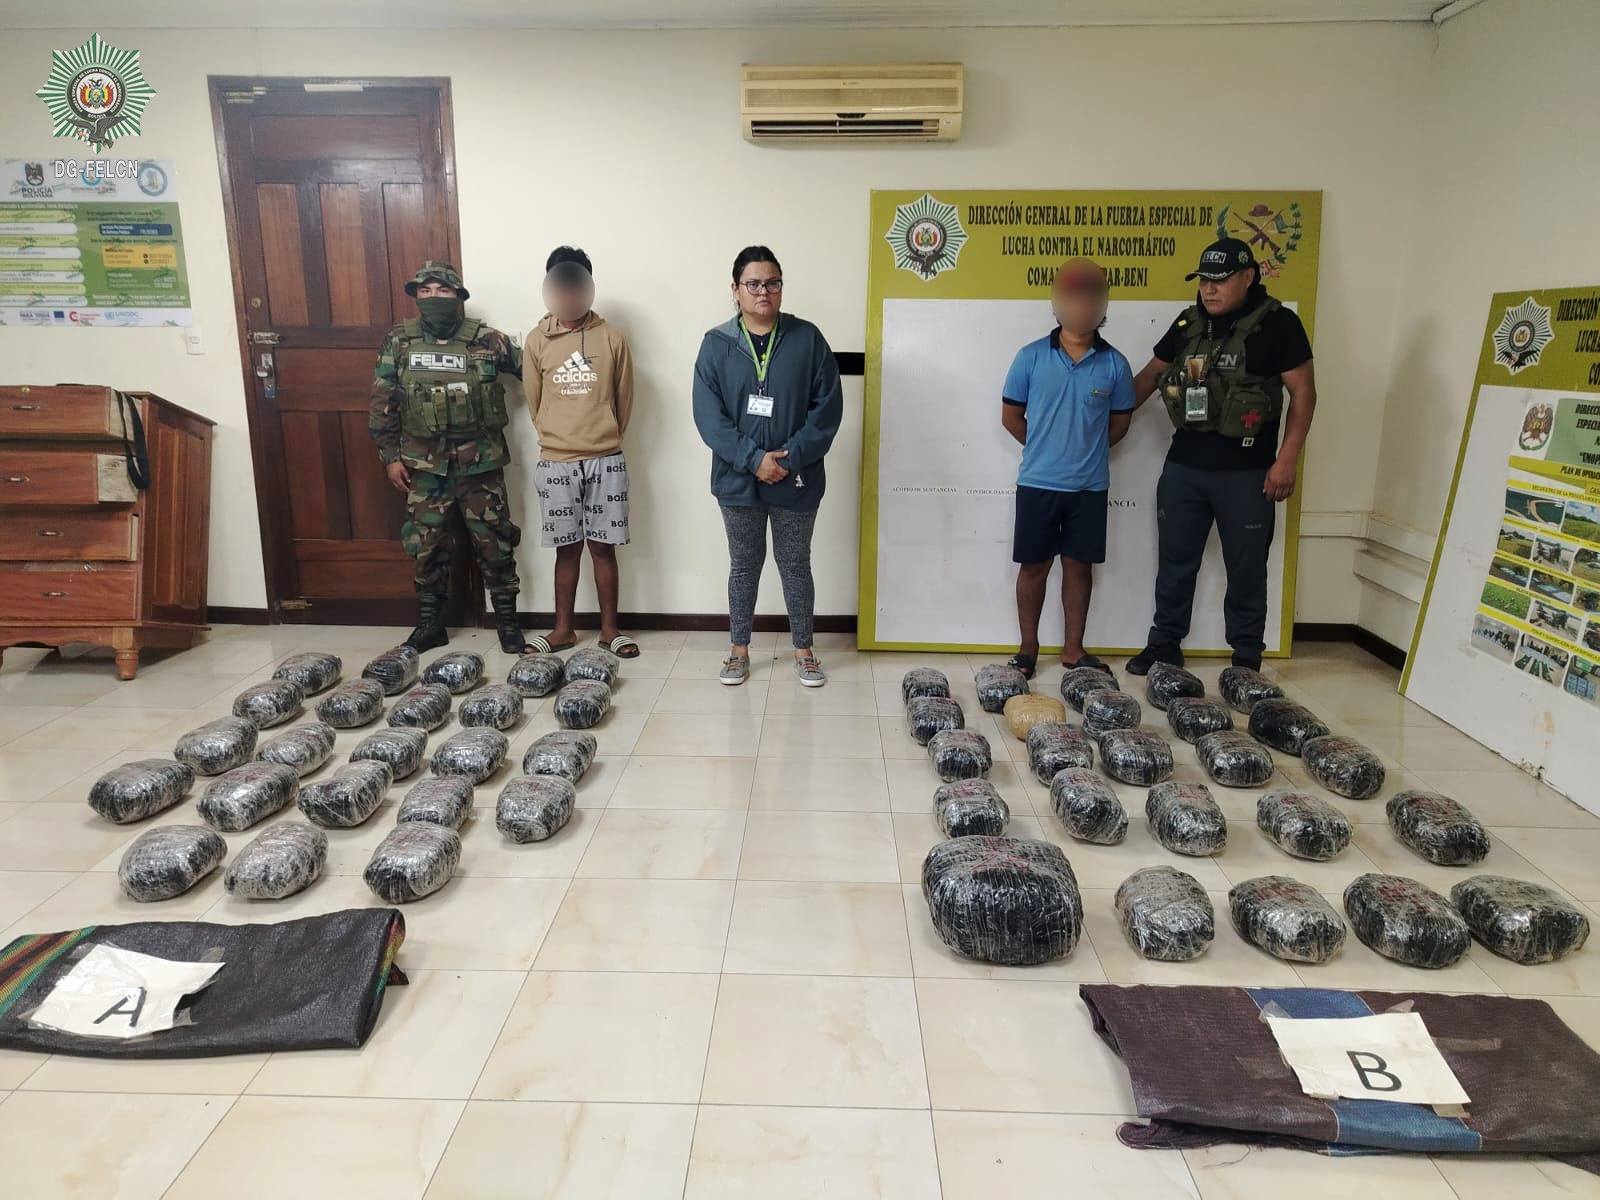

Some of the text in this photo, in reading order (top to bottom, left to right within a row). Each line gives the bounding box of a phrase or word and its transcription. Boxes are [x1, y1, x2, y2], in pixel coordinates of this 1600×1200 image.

[968, 200, 1213, 227] DIRECCIÓN GENERAL DE LA FUERZA ESPECIAL DE
[1002, 232, 1176, 257] LUCHA CONTRA EL NARCOTRÁFICO
[1027, 266, 1058, 286] COMA
[410, 353, 464, 369] FELCN
[552, 370, 598, 384] adidas
[546, 477, 570, 486] BOSS
[548, 509, 574, 517] BOSS
[553, 534, 577, 544] BOSS
[586, 530, 608, 540] BOSS
[93, 986, 147, 1027] A
[1347, 1050, 1402, 1092] B
